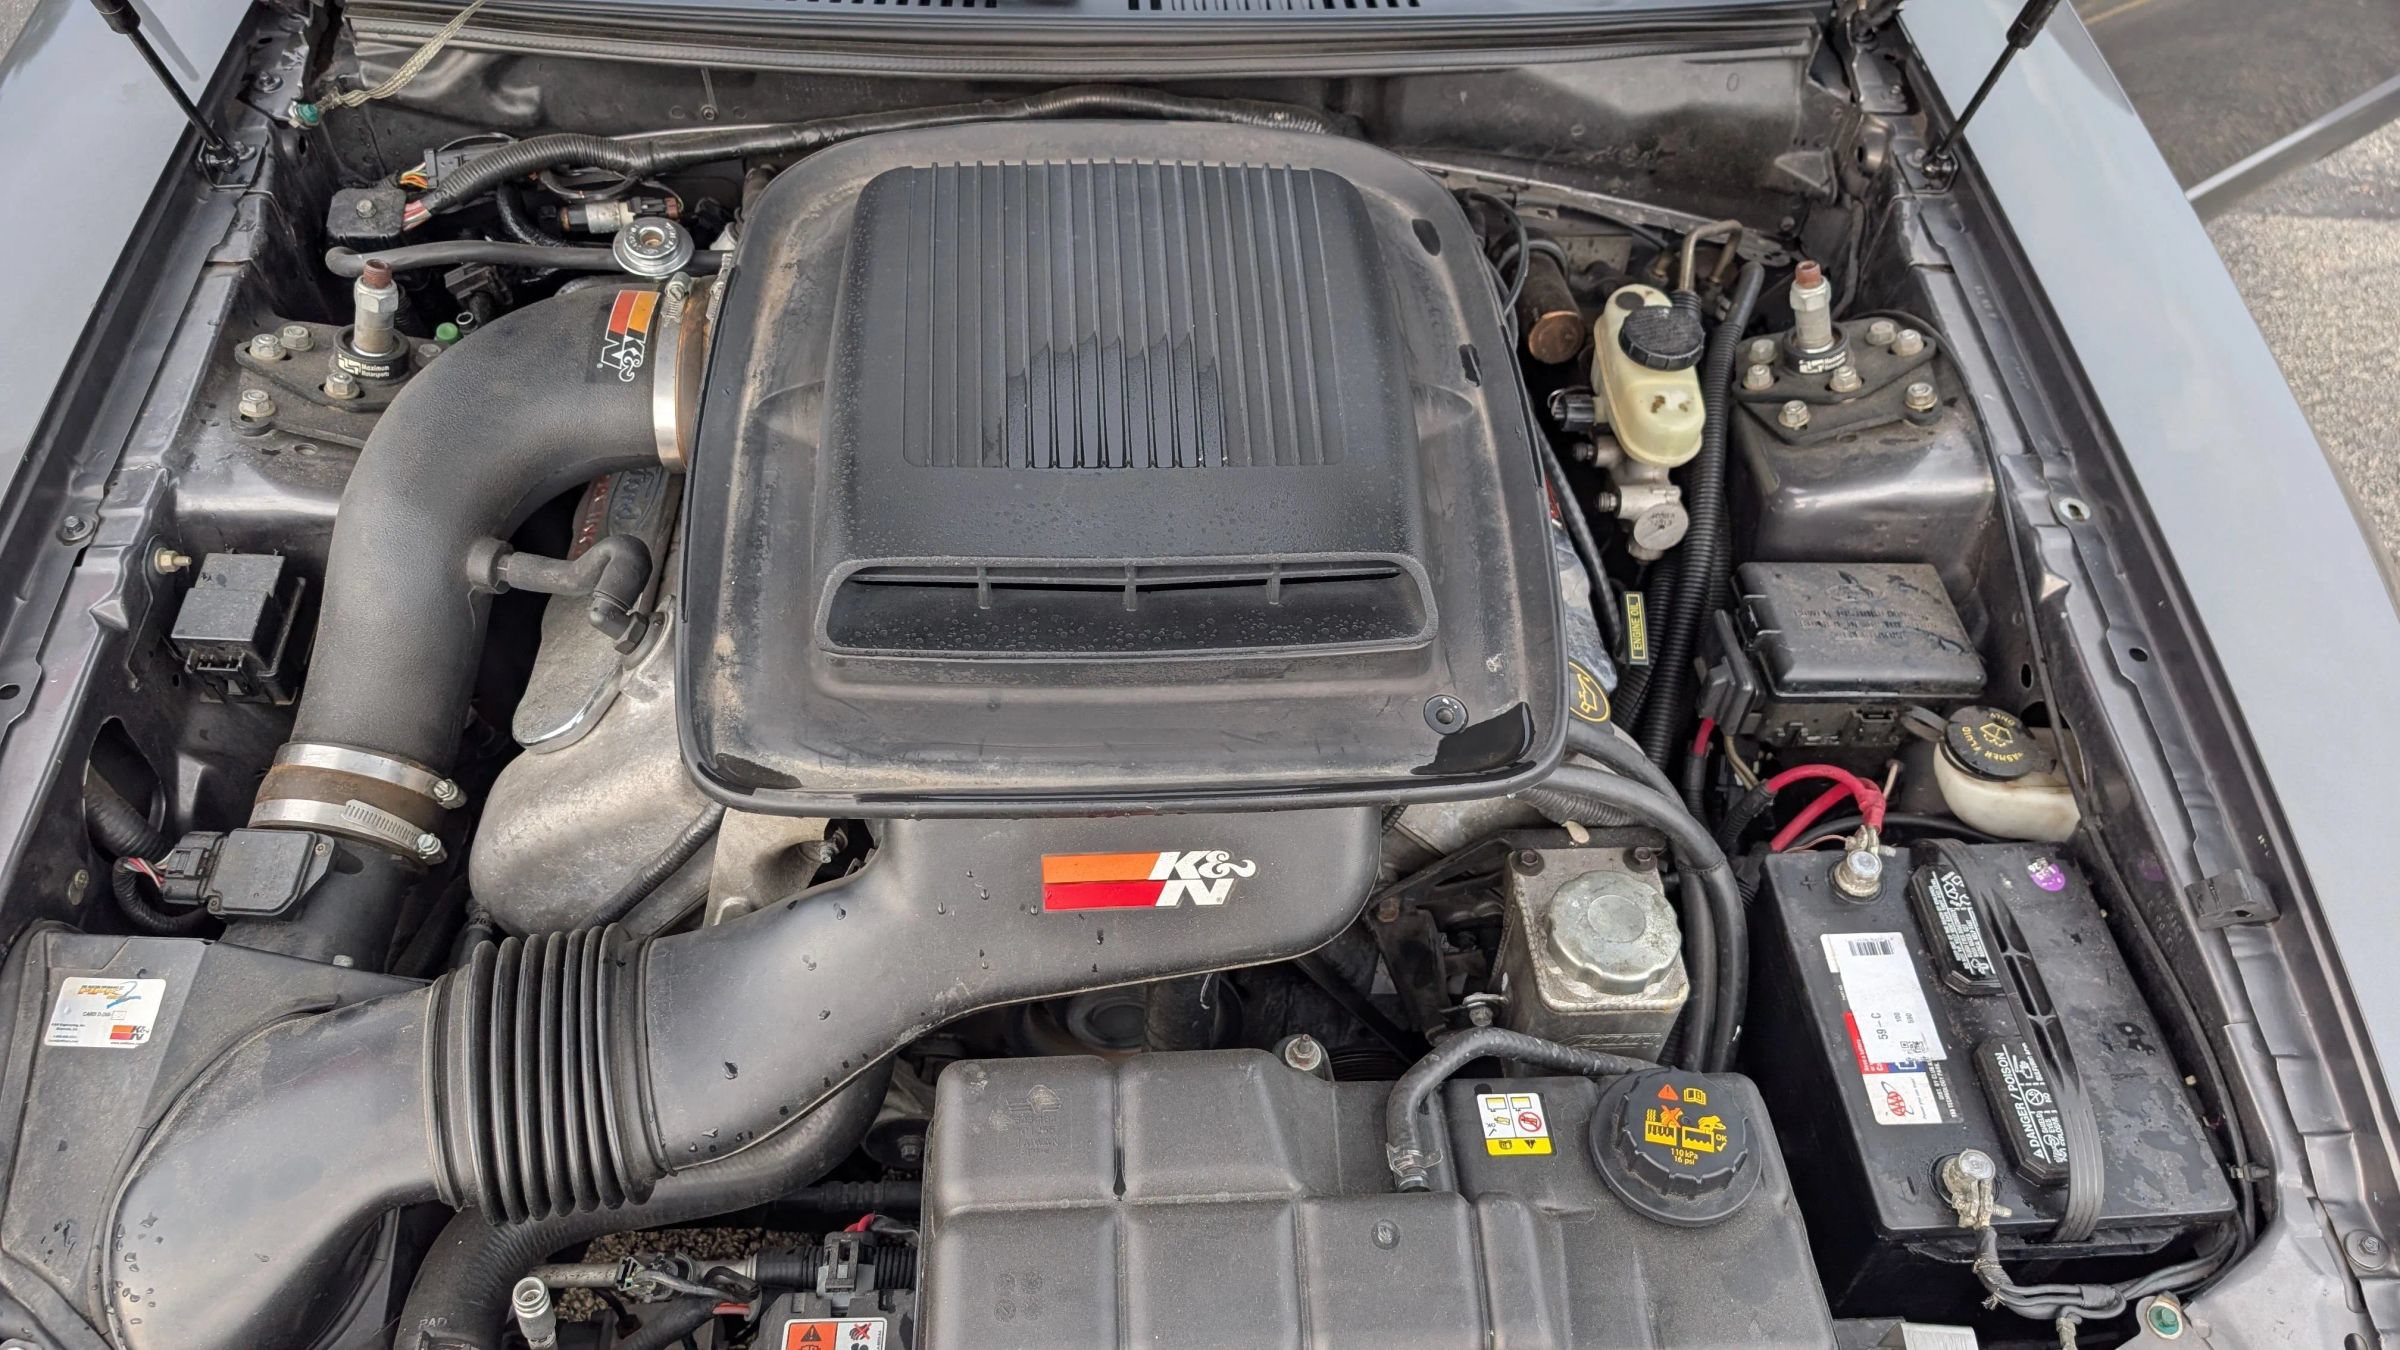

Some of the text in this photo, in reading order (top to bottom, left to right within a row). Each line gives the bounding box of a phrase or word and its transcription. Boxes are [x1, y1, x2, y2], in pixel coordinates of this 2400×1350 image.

[1630, 602, 1643, 650] ENGINE OIL
[1962, 726, 1982, 751] FLUID
[1990, 712, 2015, 726] ONLY
[1148, 850, 1256, 907] K&N
[1995, 1052, 2018, 1091] POISON
[2015, 1102, 2040, 1147] DANGER
[1671, 1148, 1698, 1159] 110 kPa
